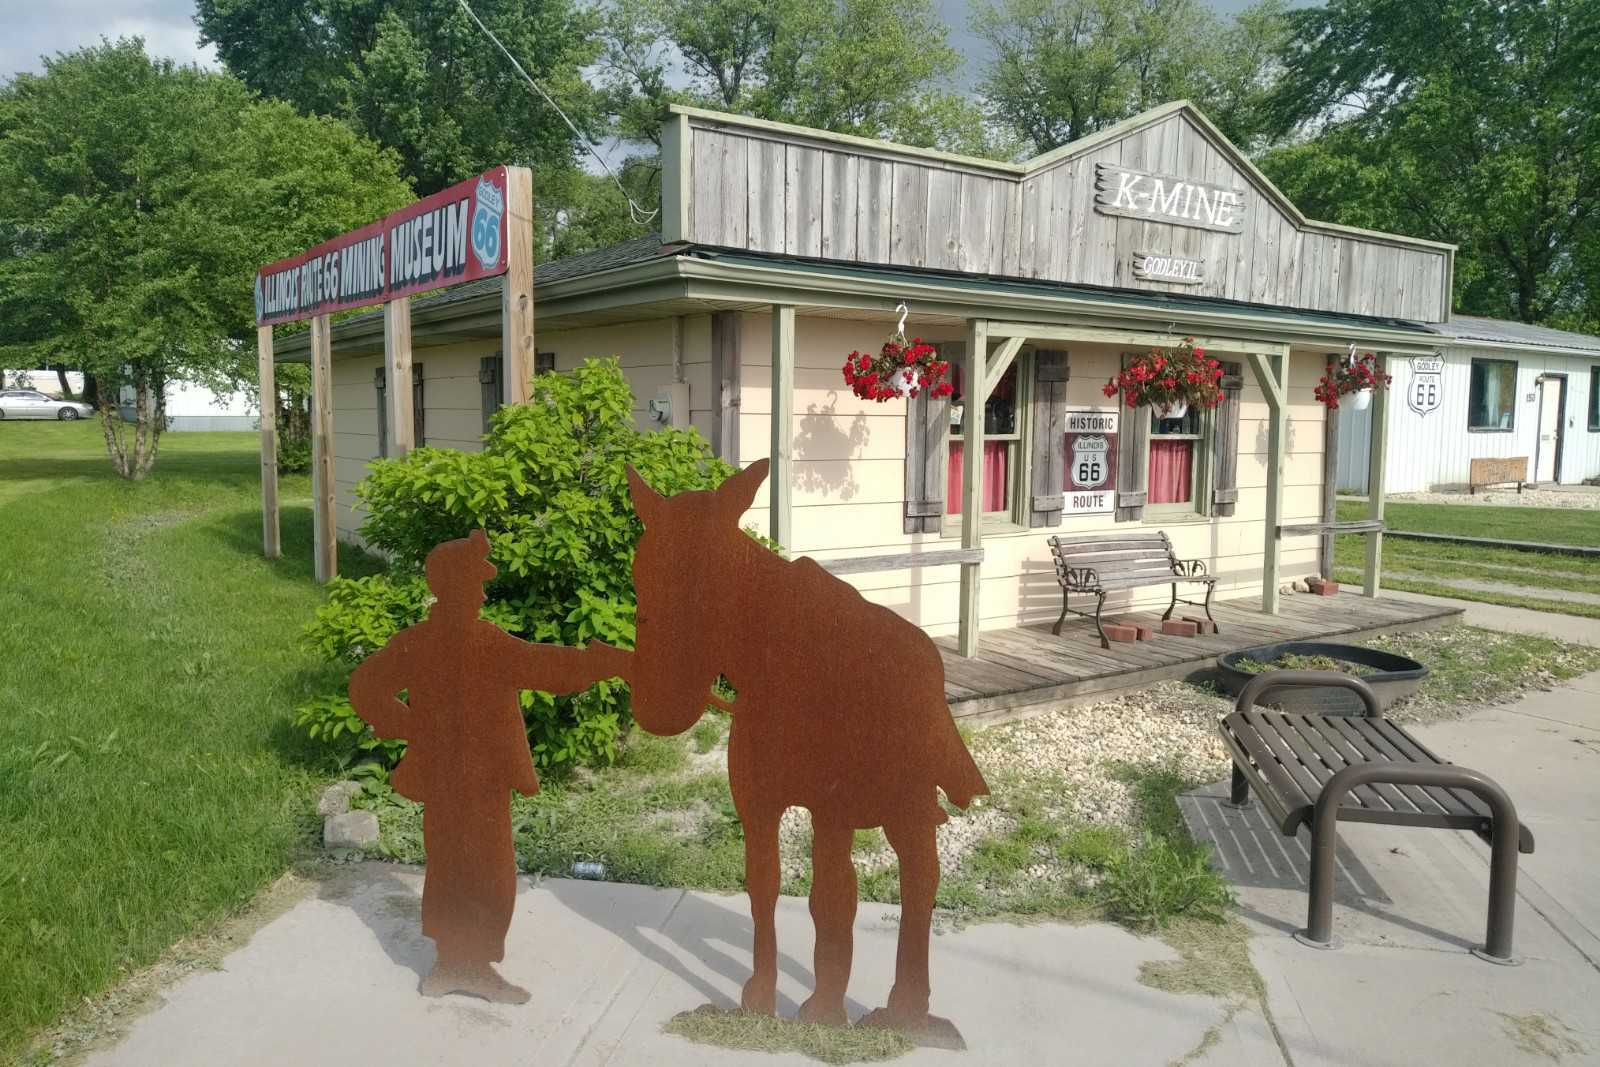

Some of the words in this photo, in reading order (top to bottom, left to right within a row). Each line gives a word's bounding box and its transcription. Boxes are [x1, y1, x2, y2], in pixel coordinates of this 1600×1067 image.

[1112, 172, 1236, 226] K-MINE
[473, 208, 499, 257] 66
[264, 267, 300, 313] ILLINOIS
[301, 256, 323, 307] ROUTE
[323, 250, 339, 300] 66
[340, 233, 385, 297] MINING
[390, 199, 469, 284] MUSEUM
[1417, 384, 1435, 405] 66
[1070, 417, 1113, 429] HISTORIC
[1079, 463, 1100, 481] 66
[1073, 495, 1104, 508] ROUTE
